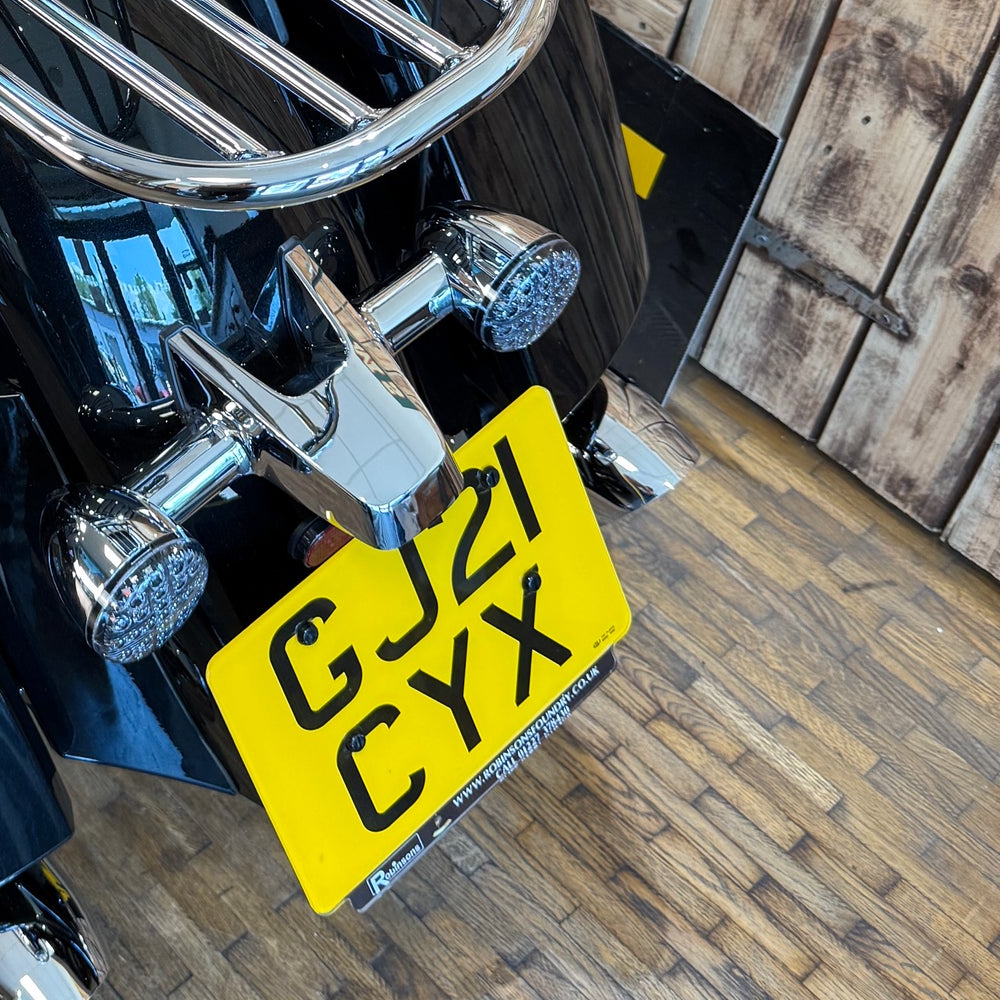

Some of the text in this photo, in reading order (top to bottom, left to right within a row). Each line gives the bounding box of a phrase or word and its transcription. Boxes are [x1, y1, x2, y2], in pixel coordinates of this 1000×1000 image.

[268, 436, 542, 731] GJ21
[337, 565, 573, 833] CYX
[452, 665, 601, 807] WWW.ROBINSONSFOUNDRY.CO.UK
[496, 757, 518, 780] CALL
[370, 844, 421, 894] Robinsons
